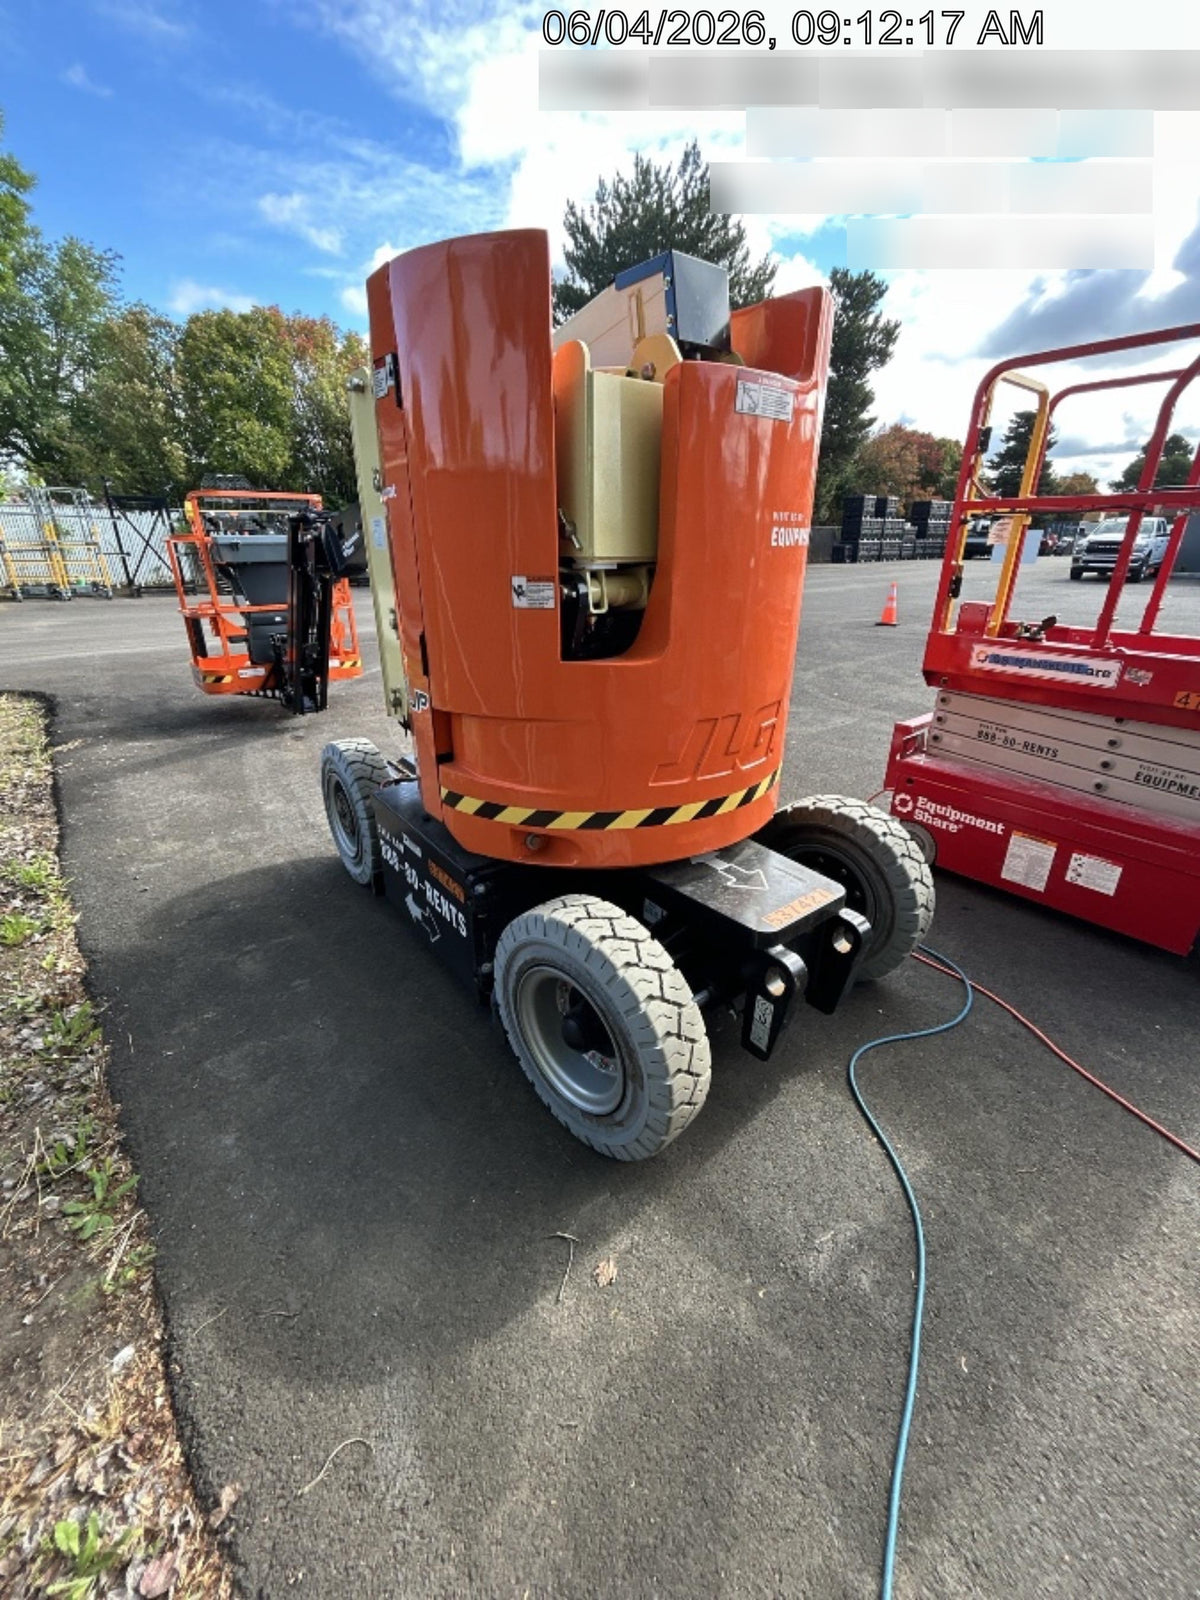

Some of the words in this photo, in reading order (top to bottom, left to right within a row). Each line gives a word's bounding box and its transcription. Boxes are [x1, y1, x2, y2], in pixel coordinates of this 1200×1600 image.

[648, 700, 782, 787] JLG
[1134, 770, 1200, 797] EQUIPME
[916, 795, 1006, 835] Equipment
